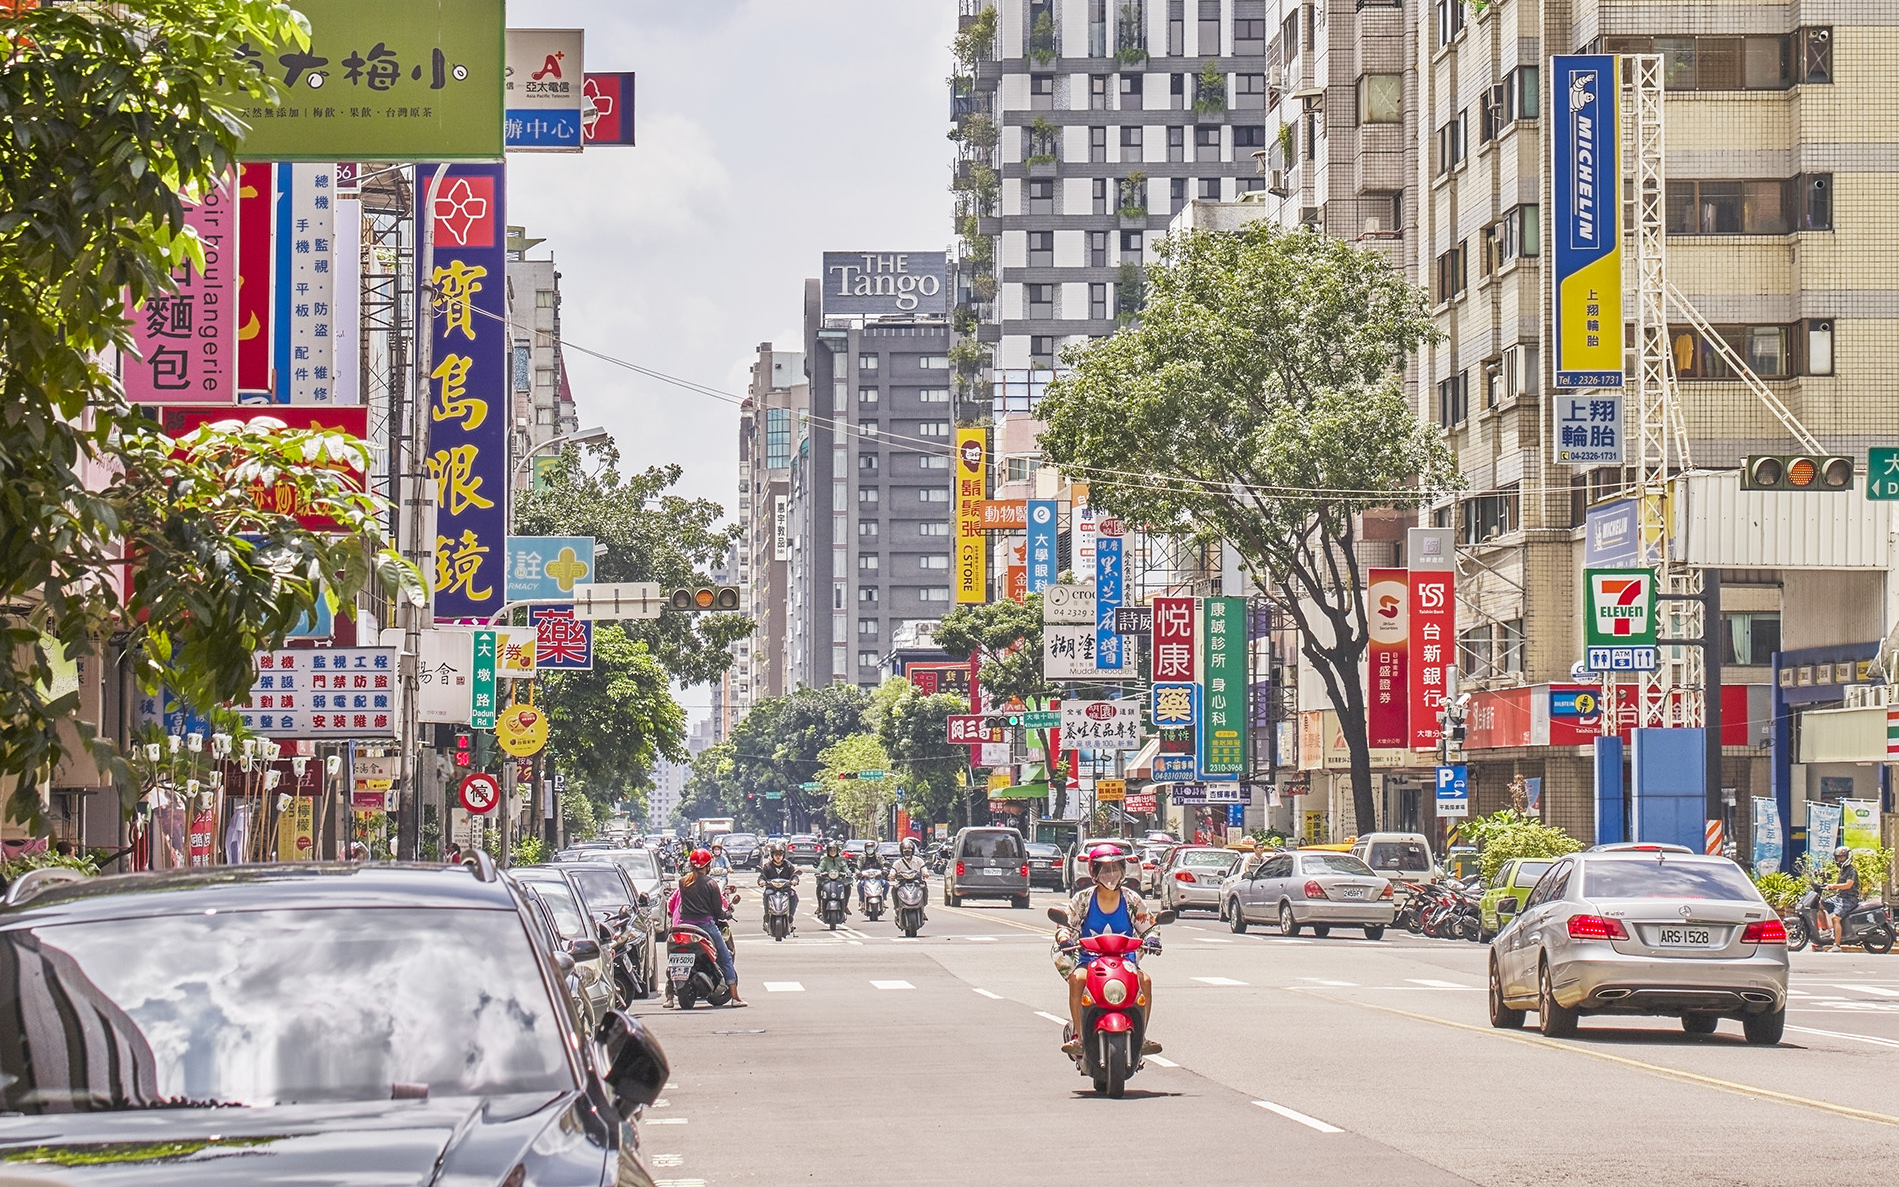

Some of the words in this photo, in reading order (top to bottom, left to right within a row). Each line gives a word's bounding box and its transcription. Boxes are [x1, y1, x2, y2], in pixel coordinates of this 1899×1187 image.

[526, 81, 570, 93] 亞太電信
[505, 119, 574, 139] 辦中心
[1578, 115, 1593, 241] MICHELIN
[861, 255, 908, 273] THE
[829, 265, 940, 310] Tango
[1586, 289, 1599, 347] 上翔輪胎
[1559, 376, 1571, 384] Tel.
[1578, 376, 1619, 385] 2326-1731
[1562, 400, 1615, 422] 上翔
[427, 259, 493, 601] 寶島眼鏡
[1562, 425, 1615, 448] 輪胎
[1571, 452, 1617, 460] 04-2326-1731
[1602, 517, 1628, 538] MICHELIN
[1034, 534, 1049, 592] 大學眼科
[533, 609, 588, 664] 藥
[1156, 603, 1191, 677] 悅康
[1211, 602, 1226, 668] 康誠診所
[313, 655, 387, 669] 監視工程
[1422, 622, 1442, 708] 台新銀行
[313, 675, 388, 688] 門禁防盜
[476, 644, 491, 707] 大墩路
[1379, 652, 1391, 703] 日盛證券
[313, 696, 388, 708] 弱電配線
[1157, 687, 1192, 722] 藥
[1211, 678, 1226, 727] 身心科
[313, 715, 388, 728] 安裝維修
[1417, 729, 1442, 738] 大墩分
[1209, 764, 1243, 772] 2310-3968
[1439, 769, 1454, 787] P
[471, 786, 489, 803] 停
